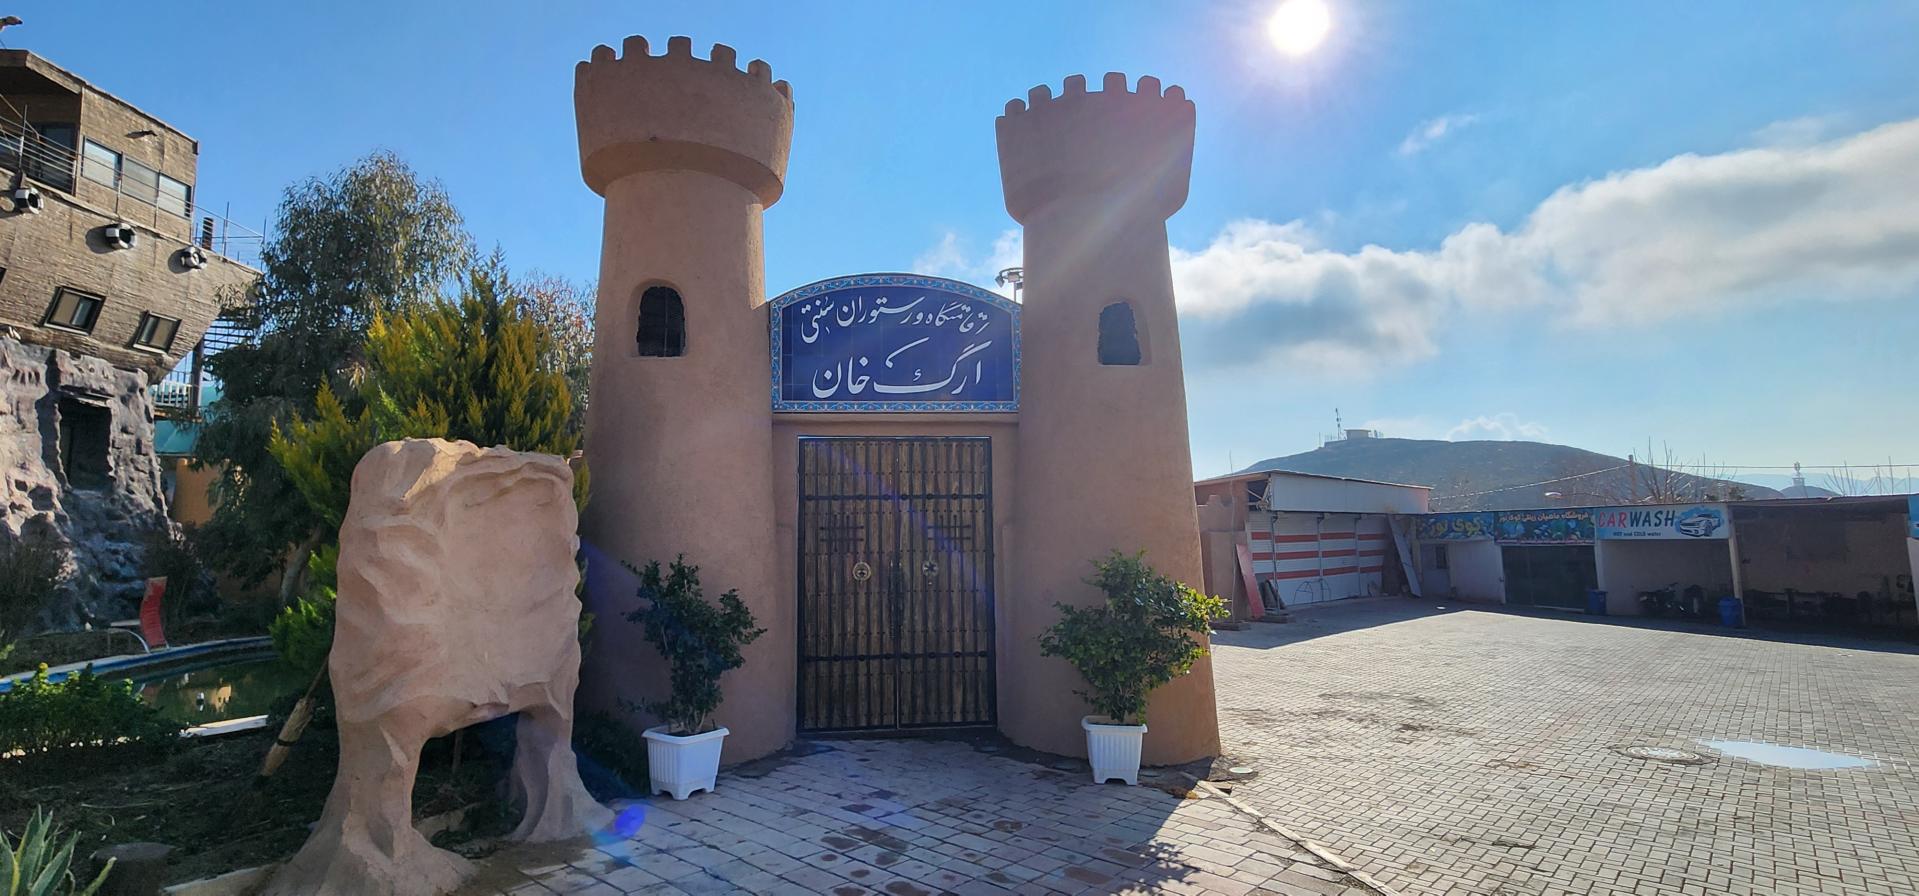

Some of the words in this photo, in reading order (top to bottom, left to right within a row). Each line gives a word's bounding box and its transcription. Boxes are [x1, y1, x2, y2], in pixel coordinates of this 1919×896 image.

[837, 296, 926, 327] رستوران
[912, 312, 923, 326] و
[812, 356, 871, 399] خان
[873, 337, 993, 395] ارگ
[1599, 511, 1628, 529] CAR
[1629, 510, 1676, 527] WASH
